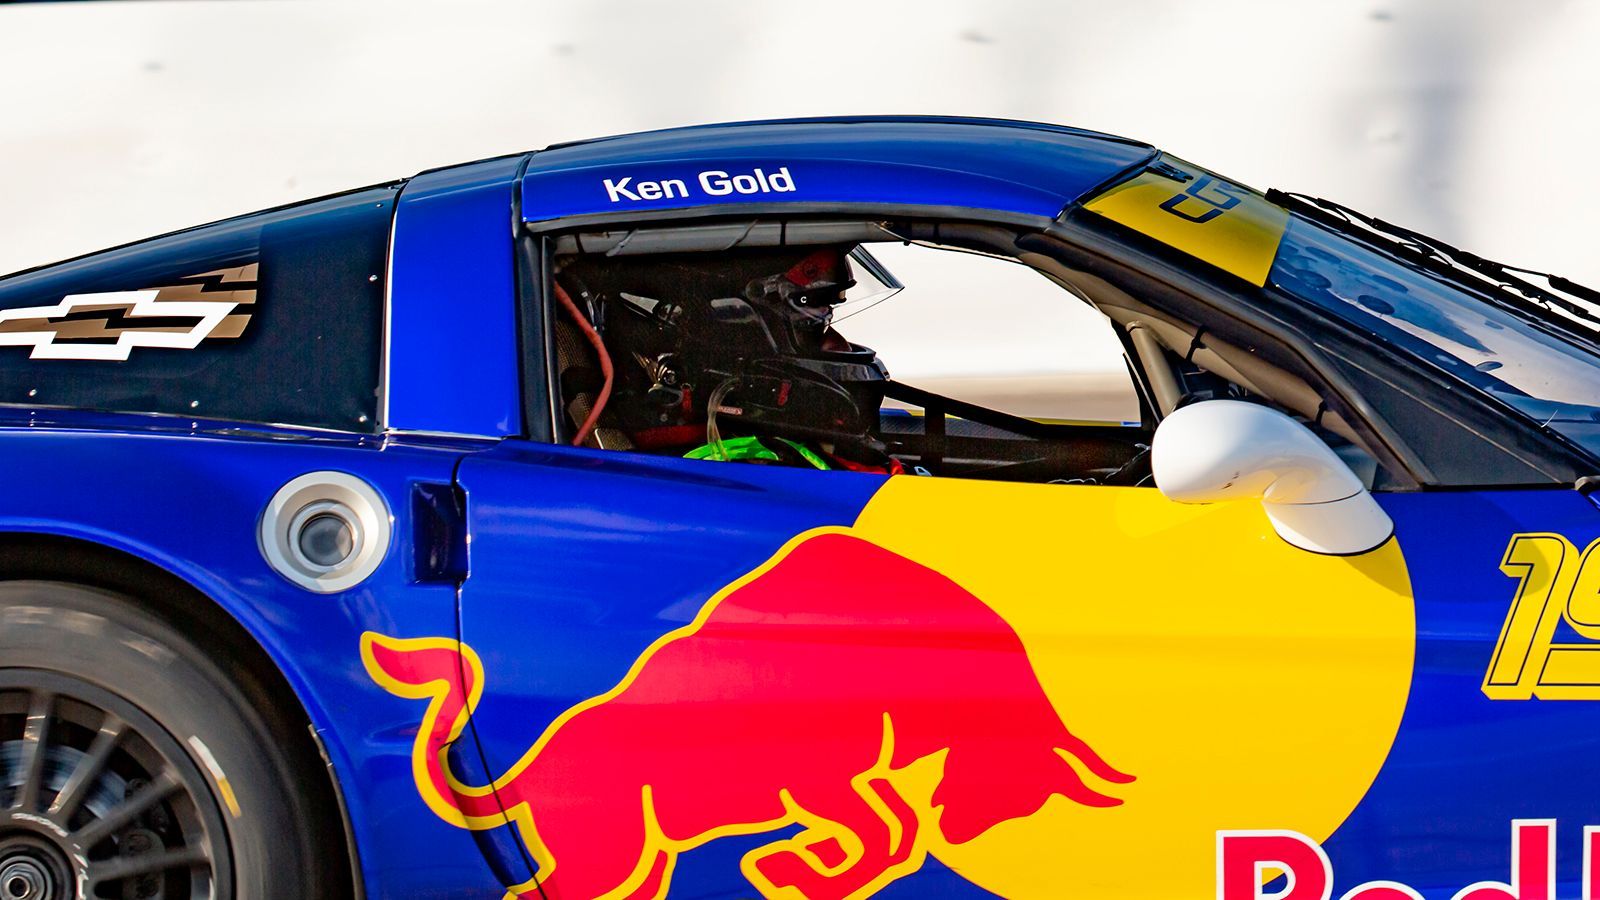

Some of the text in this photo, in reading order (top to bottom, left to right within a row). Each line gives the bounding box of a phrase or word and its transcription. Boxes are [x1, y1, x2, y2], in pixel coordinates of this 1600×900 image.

[602, 166, 797, 203] Ken Gold
[1216, 818, 1557, 900] Rd
